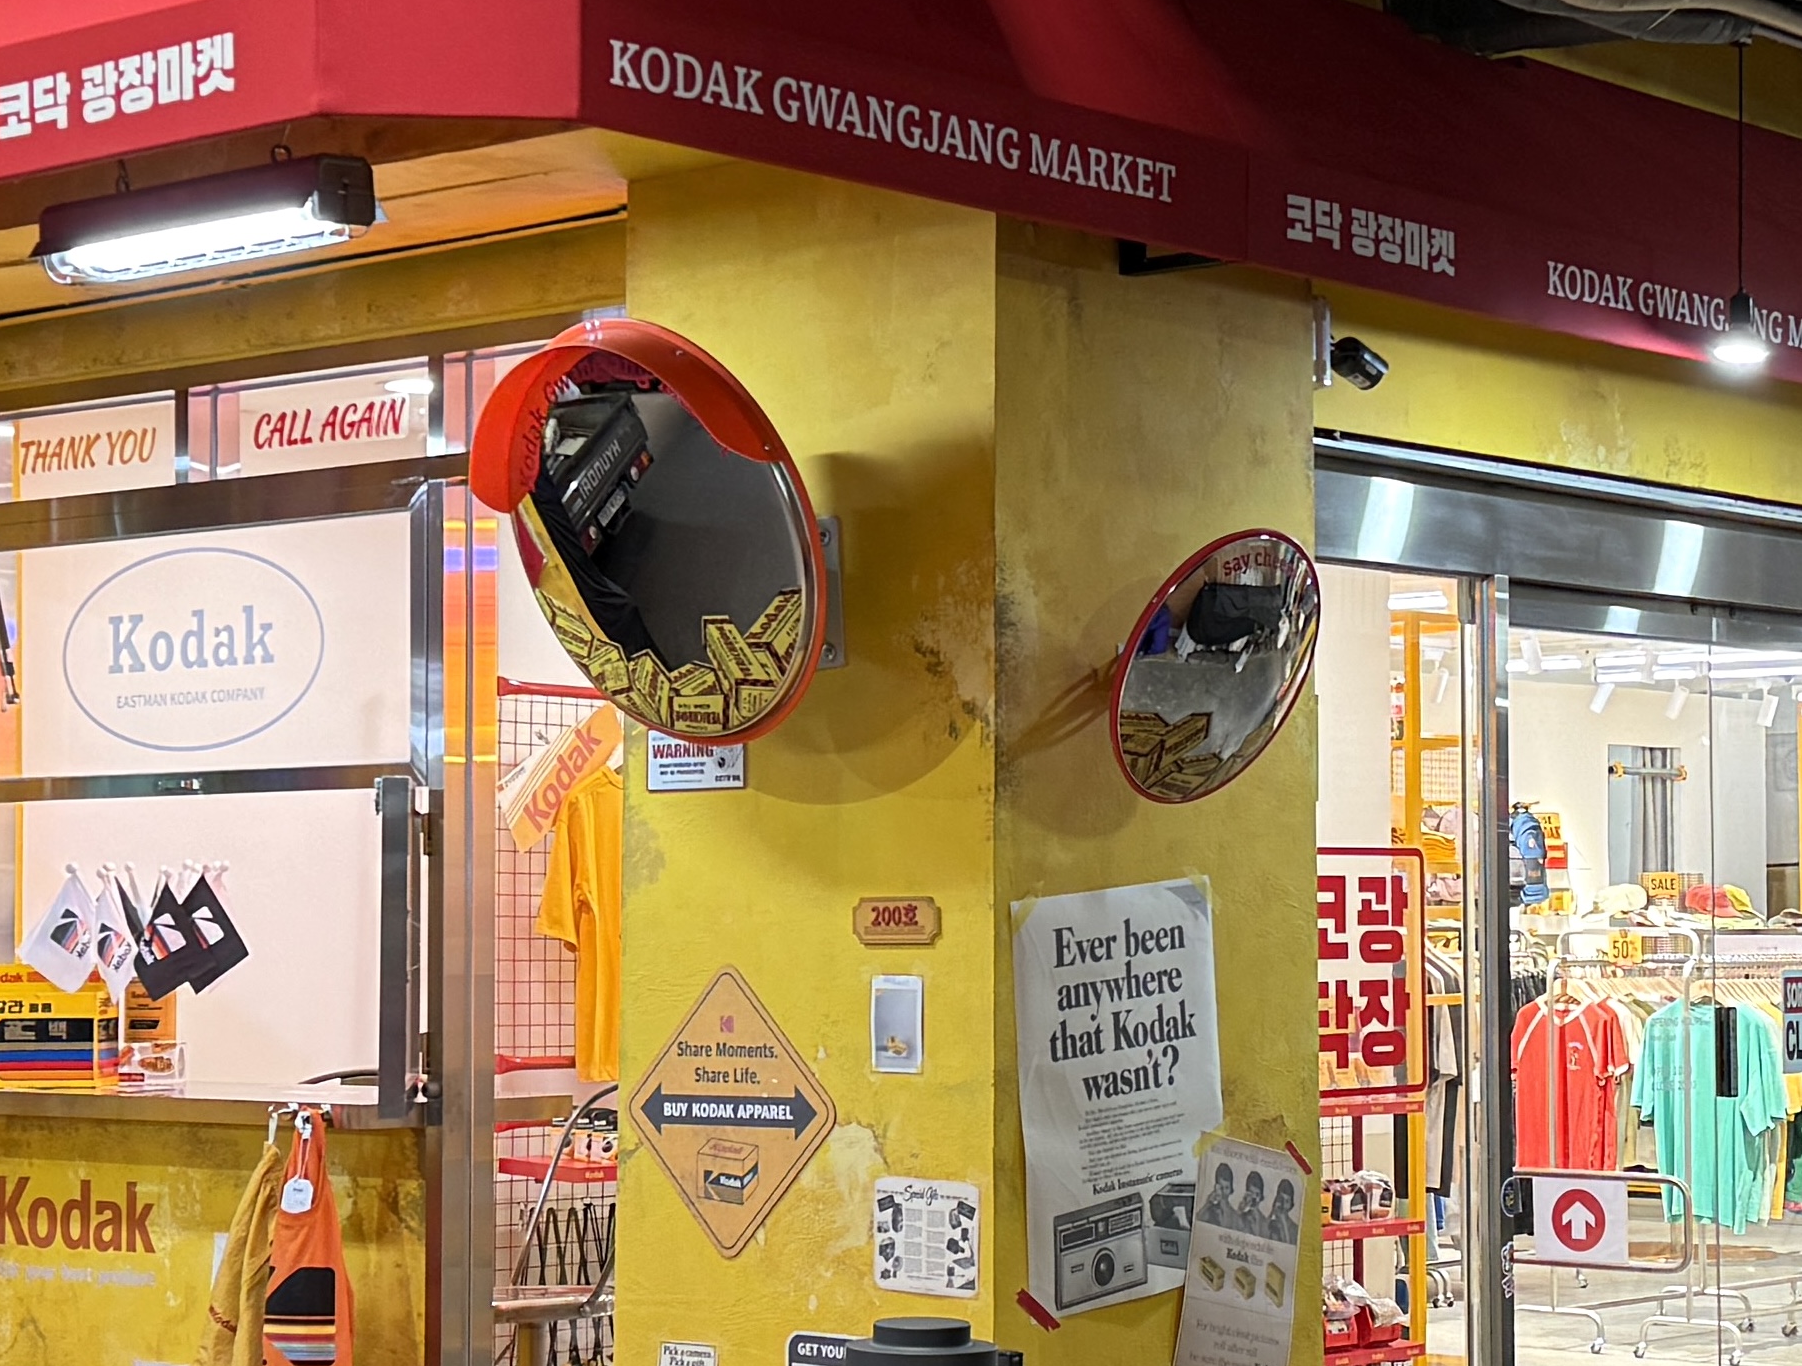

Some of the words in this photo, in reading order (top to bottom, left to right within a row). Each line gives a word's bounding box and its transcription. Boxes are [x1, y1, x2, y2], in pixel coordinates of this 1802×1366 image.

[80, 32, 236, 121] 광장마켓
[608, 37, 765, 115] KODAK
[772, 76, 1022, 171] GWANGJANG
[1028, 133, 1177, 203] MARKET
[1285, 193, 1344, 252] 코닥
[1351, 207, 1457, 279] 광장마켓
[1546, 260, 1635, 313] KODAK
[1638, 281, 1784, 345] GWANGNG
[253, 408, 314, 452] CALL
[319, 397, 406, 446] AGAIN
[20, 428, 101, 478] THANK
[105, 427, 156, 465] YOU
[1223, 551, 1252, 577] say
[108, 605, 274, 674] Kodak
[116, 694, 168, 709] EASTMAN
[170, 691, 208, 705] KODAK
[211, 687, 266, 704] COMPANY
[652, 743, 715, 760] WARNING
[522, 726, 603, 834] Kodak
[1651, 878, 1677, 891] SALE
[1052, 925, 1118, 969] Ever
[1123, 917, 1186, 958] been
[1057, 959, 1183, 1022] anywhere
[677, 1041, 713, 1057] Share
[716, 1042, 778, 1058] Moments.
[1049, 1018, 1106, 1063] that
[1111, 999, 1198, 1052] Kodak
[694, 1067, 730, 1083] Share
[733, 1067, 761, 1084] Life.
[1082, 1044, 1180, 1102] wasn't?
[663, 1102, 688, 1117] BUY
[692, 1103, 734, 1119] KODAK
[737, 1103, 794, 1121] APPAREL
[663, 1345, 680, 1357] Pick
[797, 1342, 817, 1357] GET
[821, 1344, 846, 1359] YOU
